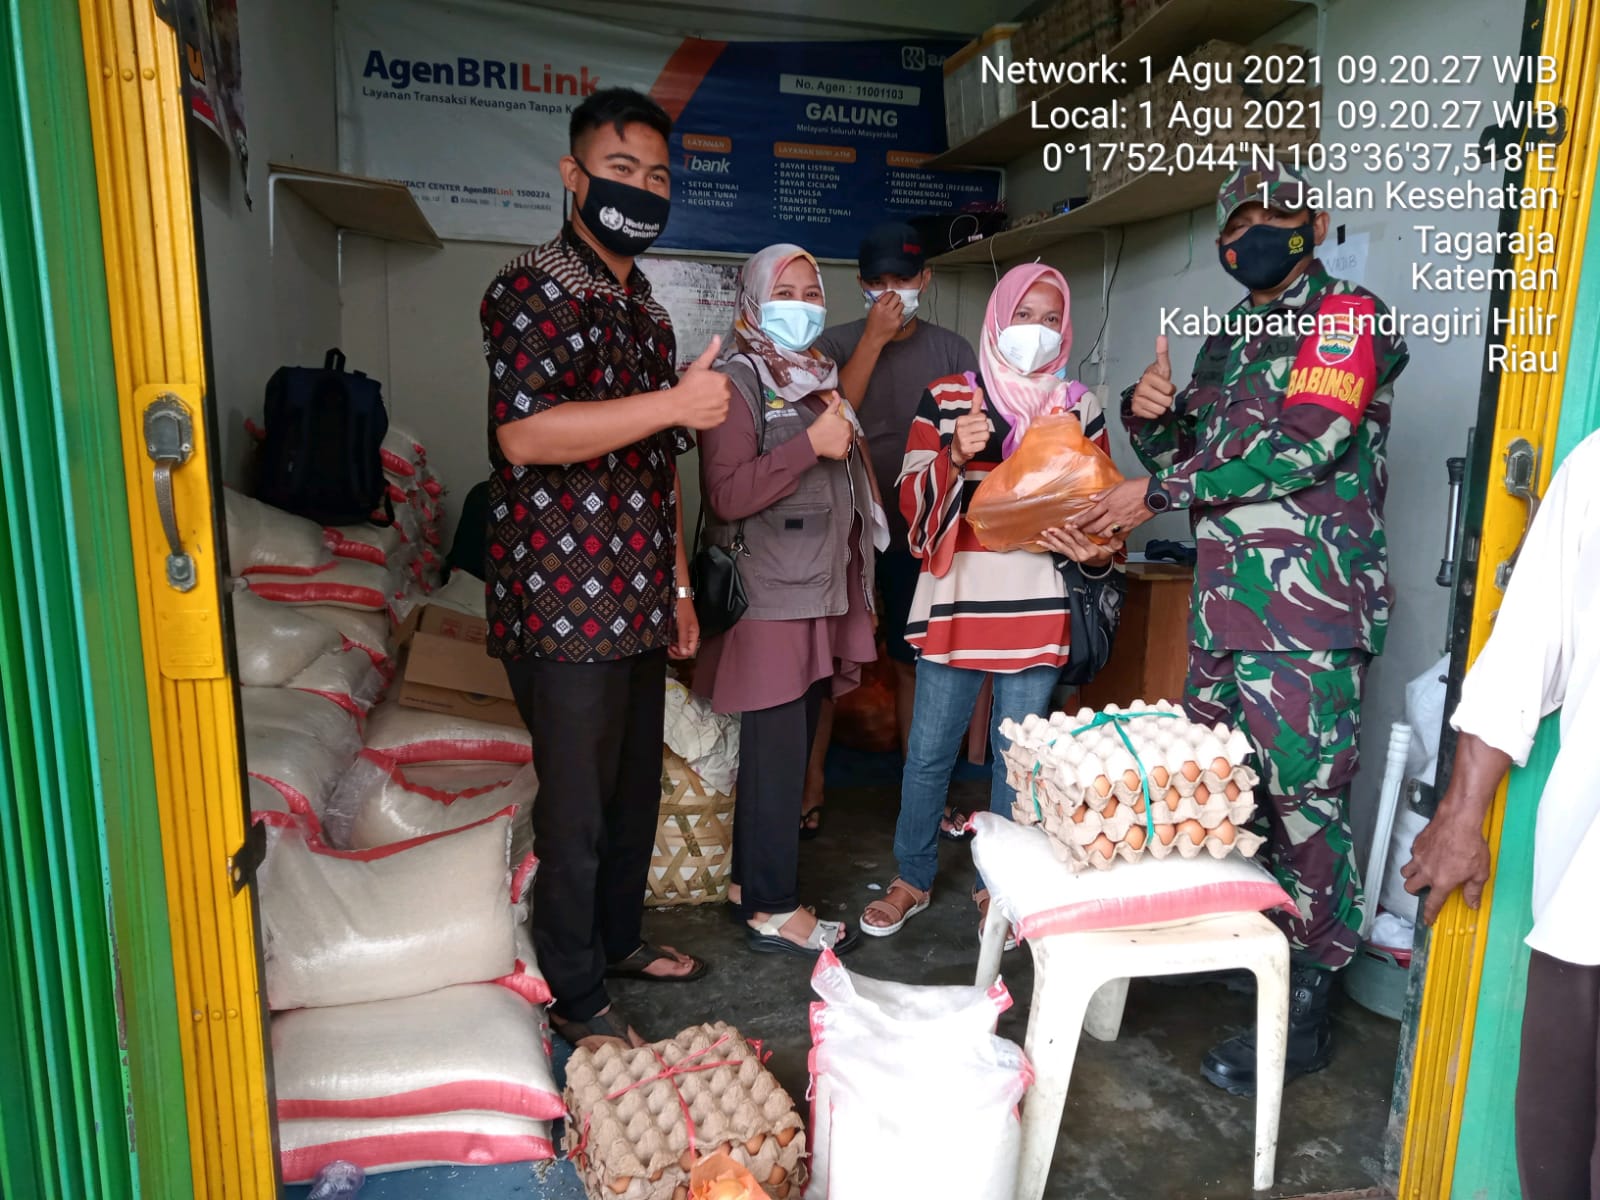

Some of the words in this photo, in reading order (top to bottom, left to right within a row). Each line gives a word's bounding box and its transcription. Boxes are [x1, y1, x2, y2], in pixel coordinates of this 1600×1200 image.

[363, 50, 600, 96] AgenBRILink
[796, 79, 814, 90] No.
[817, 81, 845, 95] Agen
[856, 86, 904, 99] 11001103
[362, 86, 411, 100] Layanan
[414, 91, 467, 105] Transaksi
[470, 98, 526, 111] Keuangan
[528, 101, 562, 115] Tanpa
[805, 102, 898, 127] GALUNG
[779, 162, 805, 170] BAYAR
[807, 164, 836, 172] LISTRIK
[779, 170, 805, 179] BAYAR
[807, 172, 840, 181] TELEPON
[428, 182, 461, 192] CENTER
[463, 185, 514, 196] AgenBRILink
[688, 181, 713, 190] SETOR
[715, 183, 739, 191] TUNAI
[779, 179, 805, 187] BAYAR
[807, 180, 838, 189] CICILAN
[890, 180, 918, 188] KREDIT
[919, 181, 944, 190] MIKRO
[688, 189, 711, 198] TARIK
[713, 191, 737, 199] TUNAI
[779, 187, 796, 195] BELI
[798, 189, 822, 197] PULSA
[688, 198, 734, 207] REGISTRASI
[779, 196, 818, 205] TRANSFER
[890, 197, 928, 206] ASURANSI
[928, 199, 953, 208] MIKRO
[779, 204, 827, 215] TARIK/SETOR
[828, 208, 851, 217] TUNAI
[779, 213, 793, 221] TOP
[795, 214, 805, 222] UP
[1286, 366, 1365, 409] BABINSA
